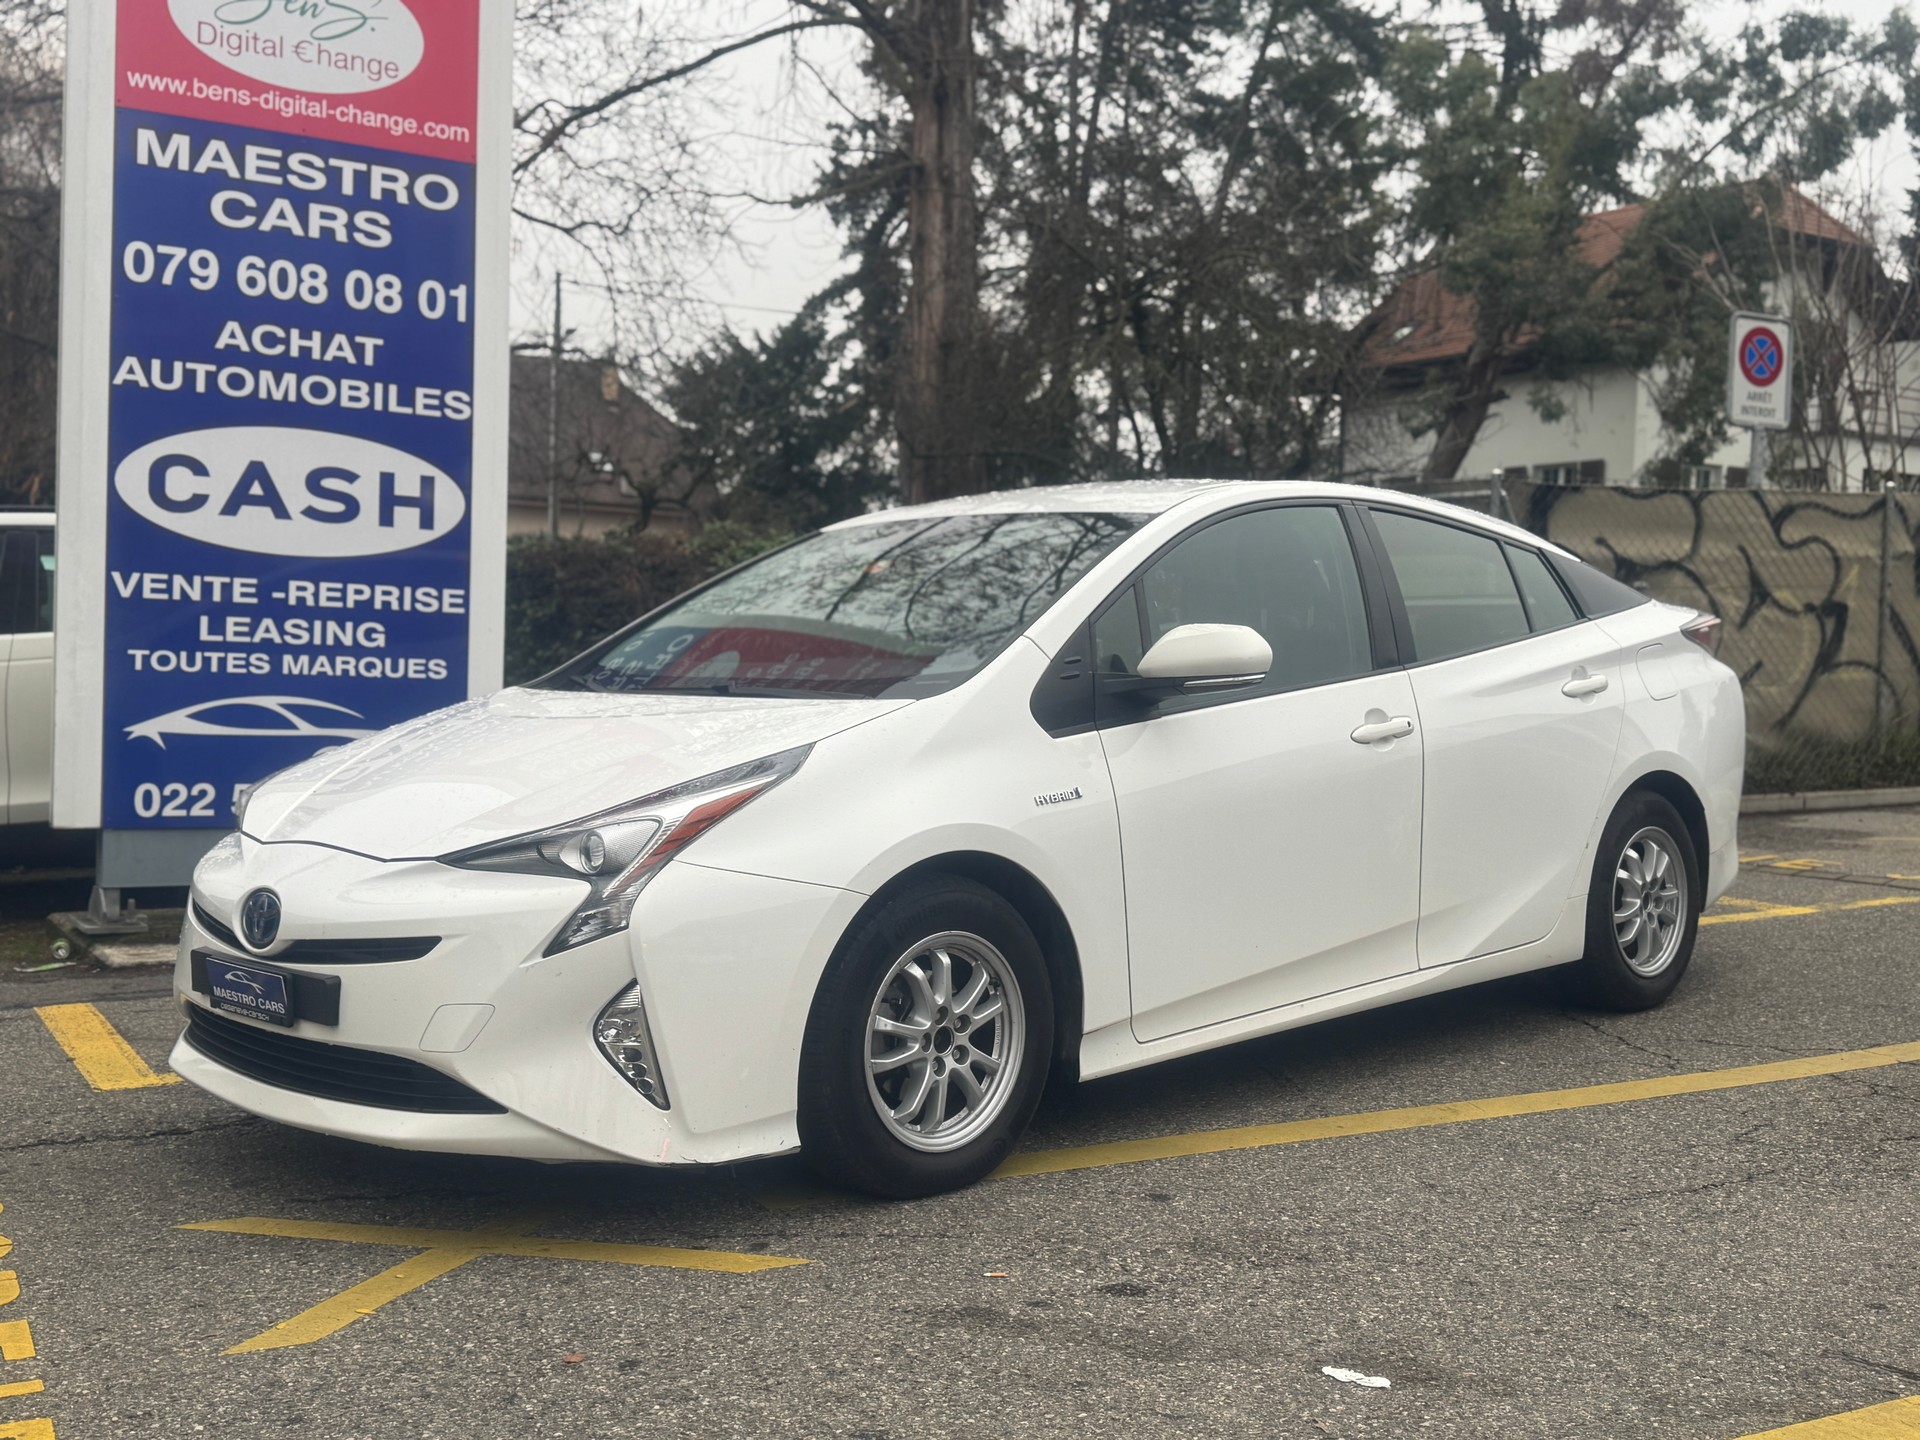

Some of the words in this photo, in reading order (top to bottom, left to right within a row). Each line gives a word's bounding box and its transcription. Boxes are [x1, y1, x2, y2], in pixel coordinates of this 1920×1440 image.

[197, 21, 284, 57] Digital
[126, 69, 470, 143] www.bens-digital-change.com
[136, 127, 460, 211] MAESTRO
[210, 189, 393, 248] CARS
[123, 240, 220, 291] 079
[236, 255, 329, 305] 608
[344, 269, 403, 314] 08
[417, 279, 468, 323] 01
[214, 320, 385, 367] ACHAT
[112, 355, 473, 421] AUTOMOBILES
[148, 453, 436, 531] CASH
[111, 571, 259, 604] VENTE
[199, 615, 386, 648] LEASING
[127, 649, 271, 675] TOUTES
[282, 654, 448, 680] MARQUES
[134, 782, 216, 818] 022
[1033, 789, 1077, 807] HYBRID
[213, 985, 256, 1007] MAESTRO
[258, 998, 286, 1014] CARS
